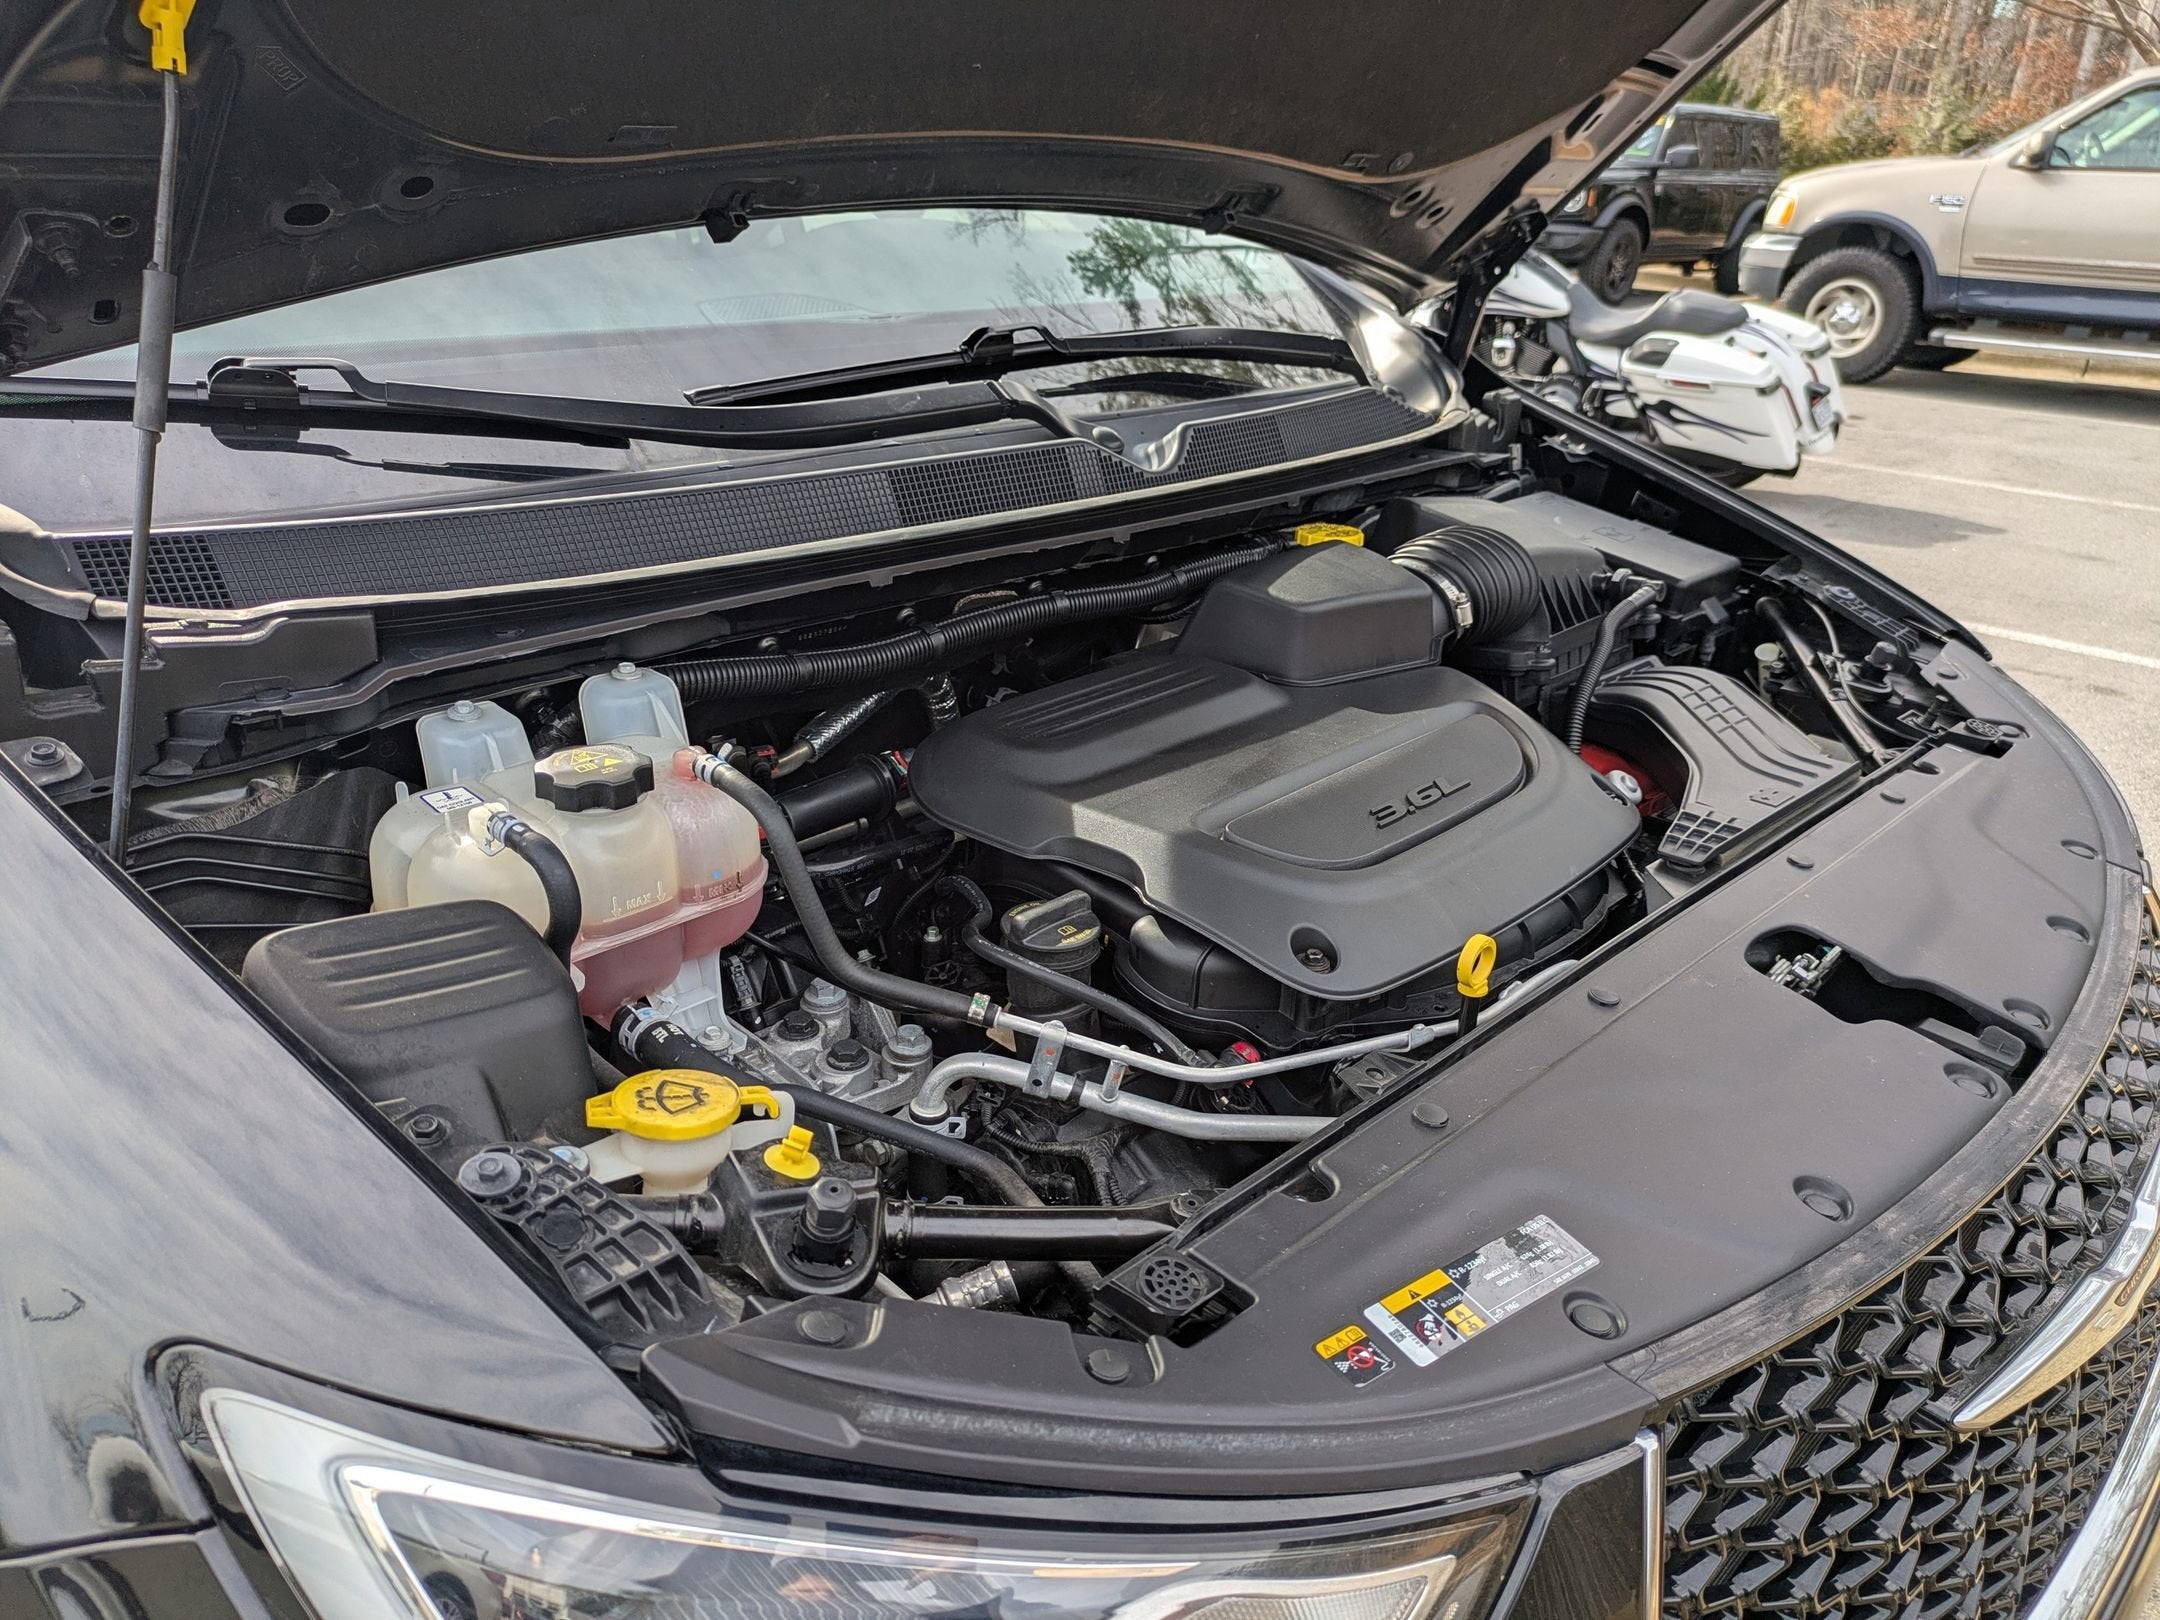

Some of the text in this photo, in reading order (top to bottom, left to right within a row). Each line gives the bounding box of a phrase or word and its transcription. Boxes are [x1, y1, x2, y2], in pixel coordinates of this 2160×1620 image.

[1369, 777, 1471, 830] 3.6L
[626, 893, 652, 909] MAX
[651, 1026, 669, 1044] BTL
[1457, 1254, 1488, 1275] R-1234yf
[1503, 1299, 1521, 1313] PAG
